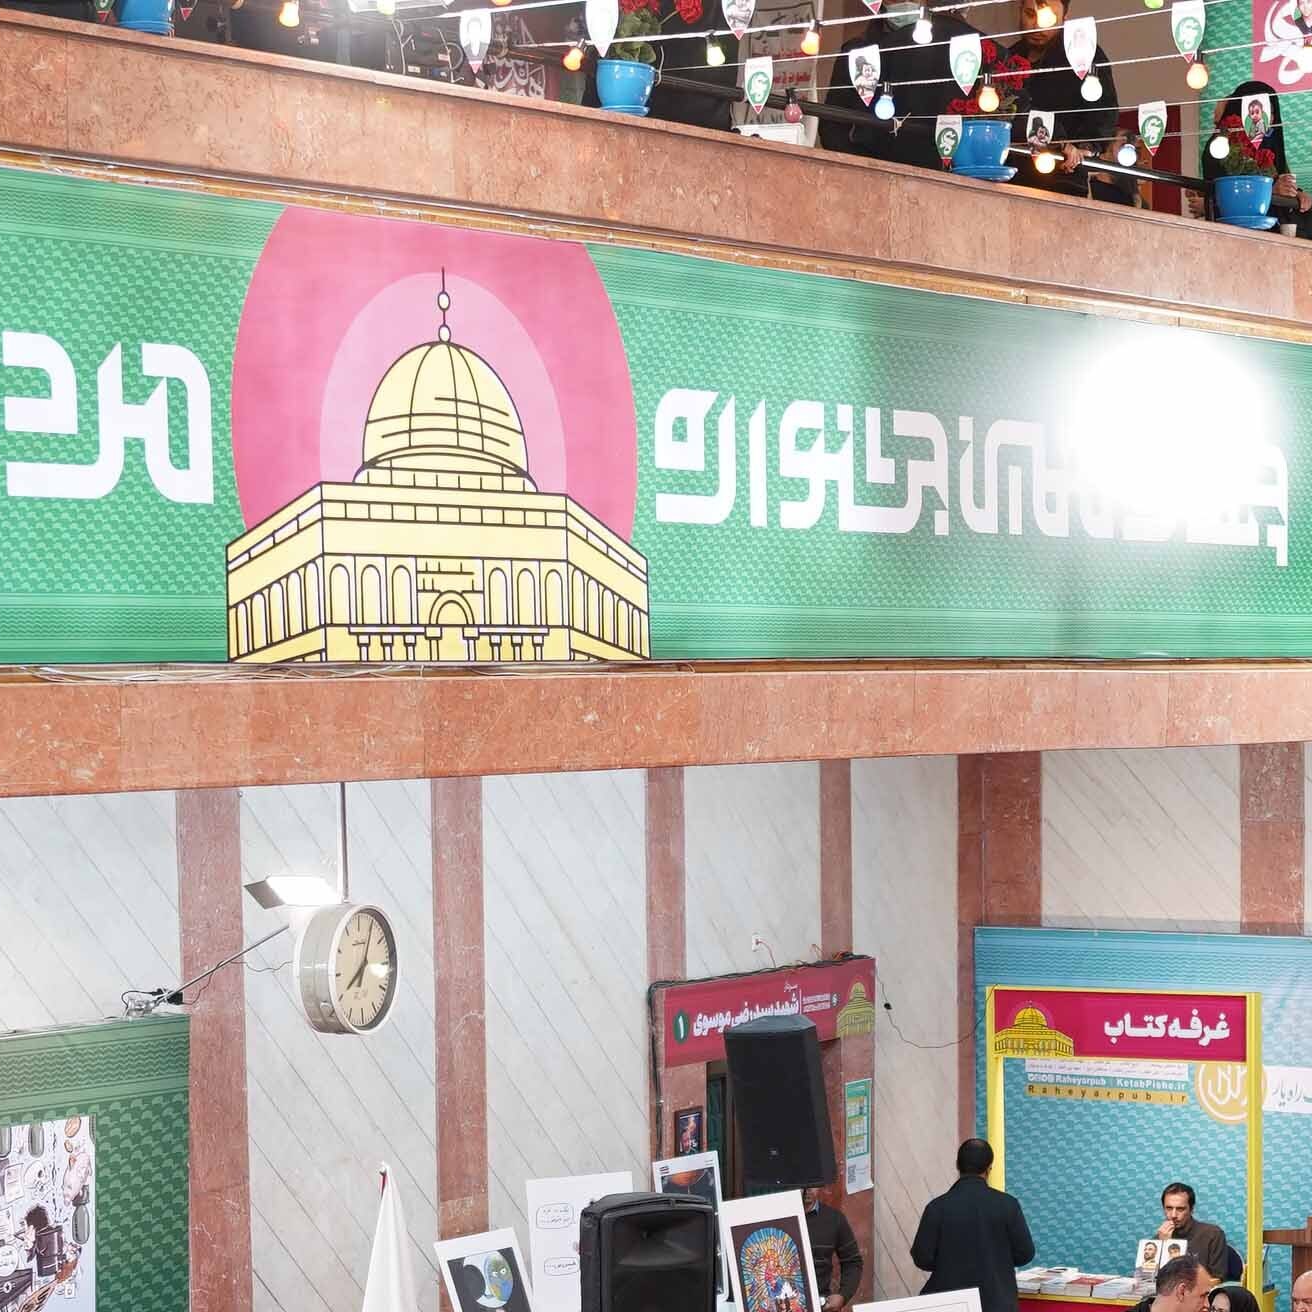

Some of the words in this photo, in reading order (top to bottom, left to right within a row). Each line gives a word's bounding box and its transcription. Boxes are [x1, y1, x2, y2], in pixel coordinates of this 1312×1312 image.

[654, 387, 950, 536] جشنواره
[1103, 1011, 1169, 1045] کتاب
[1168, 1008, 1231, 1047] غرفه
